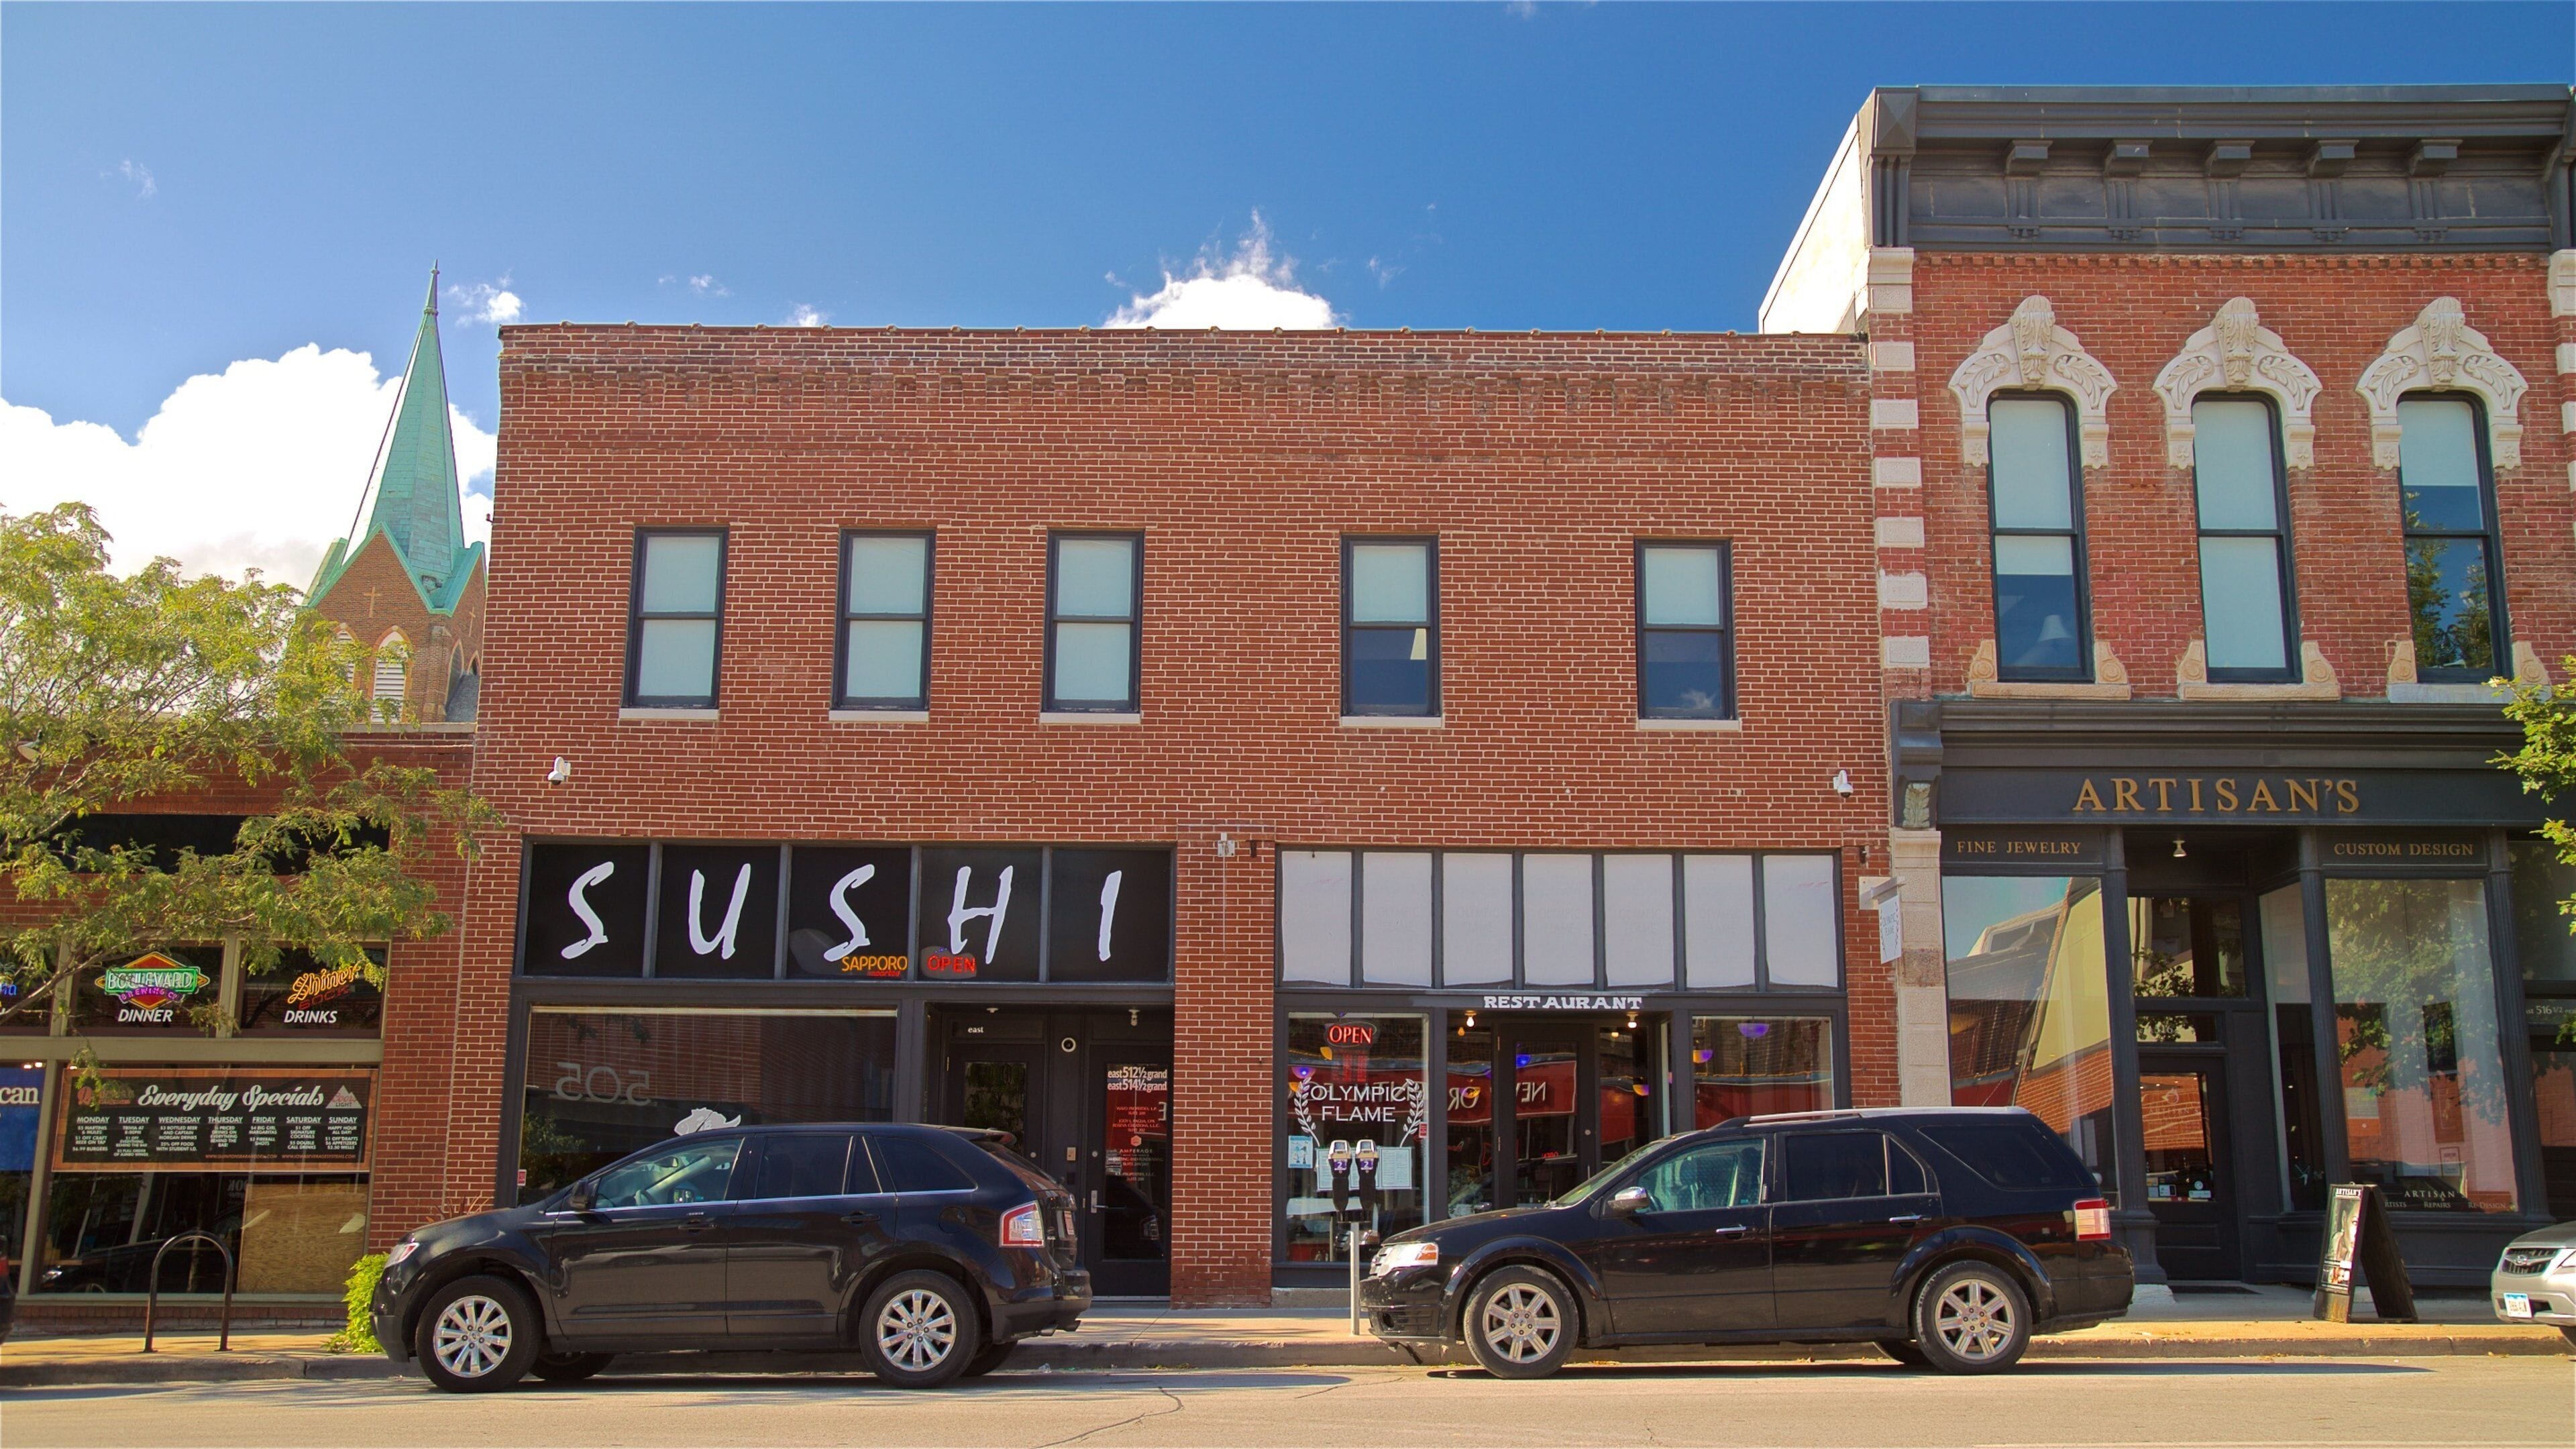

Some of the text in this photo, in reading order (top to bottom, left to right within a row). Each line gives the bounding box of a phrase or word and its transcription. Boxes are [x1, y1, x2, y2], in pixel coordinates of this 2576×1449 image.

[2072, 777, 2360, 813] ARTISAN'S
[1957, 841, 2081, 854] FINE JEWELRY
[2334, 843, 2474, 856] CUSTOM DESIGN
[561, 861, 1122, 965] SUSHI
[841, 955, 908, 971] SAPPORO
[927, 955, 977, 973] OPEN
[107, 971, 193, 989] BOULEVARD
[121, 986, 165, 1000] BREWING
[1483, 996, 1642, 1010] RESTAURANT
[2536, 1006, 2552, 1014] 516
[118, 1009, 174, 1022] DINNER
[284, 1010, 338, 1024] DRINKS
[1329, 1025, 1373, 1044] OPEN
[1108, 1069, 1122, 1078] east
[1147, 1069, 1167, 1081] grand
[1107, 1081, 1122, 1090] east
[1146, 1081, 1167, 1093] grand
[1310, 1085, 1407, 1102] OLYMPIC
[138, 1085, 239, 1112] Everyday
[242, 1085, 324, 1112] Specials
[1322, 1106, 1396, 1122] FLAME
